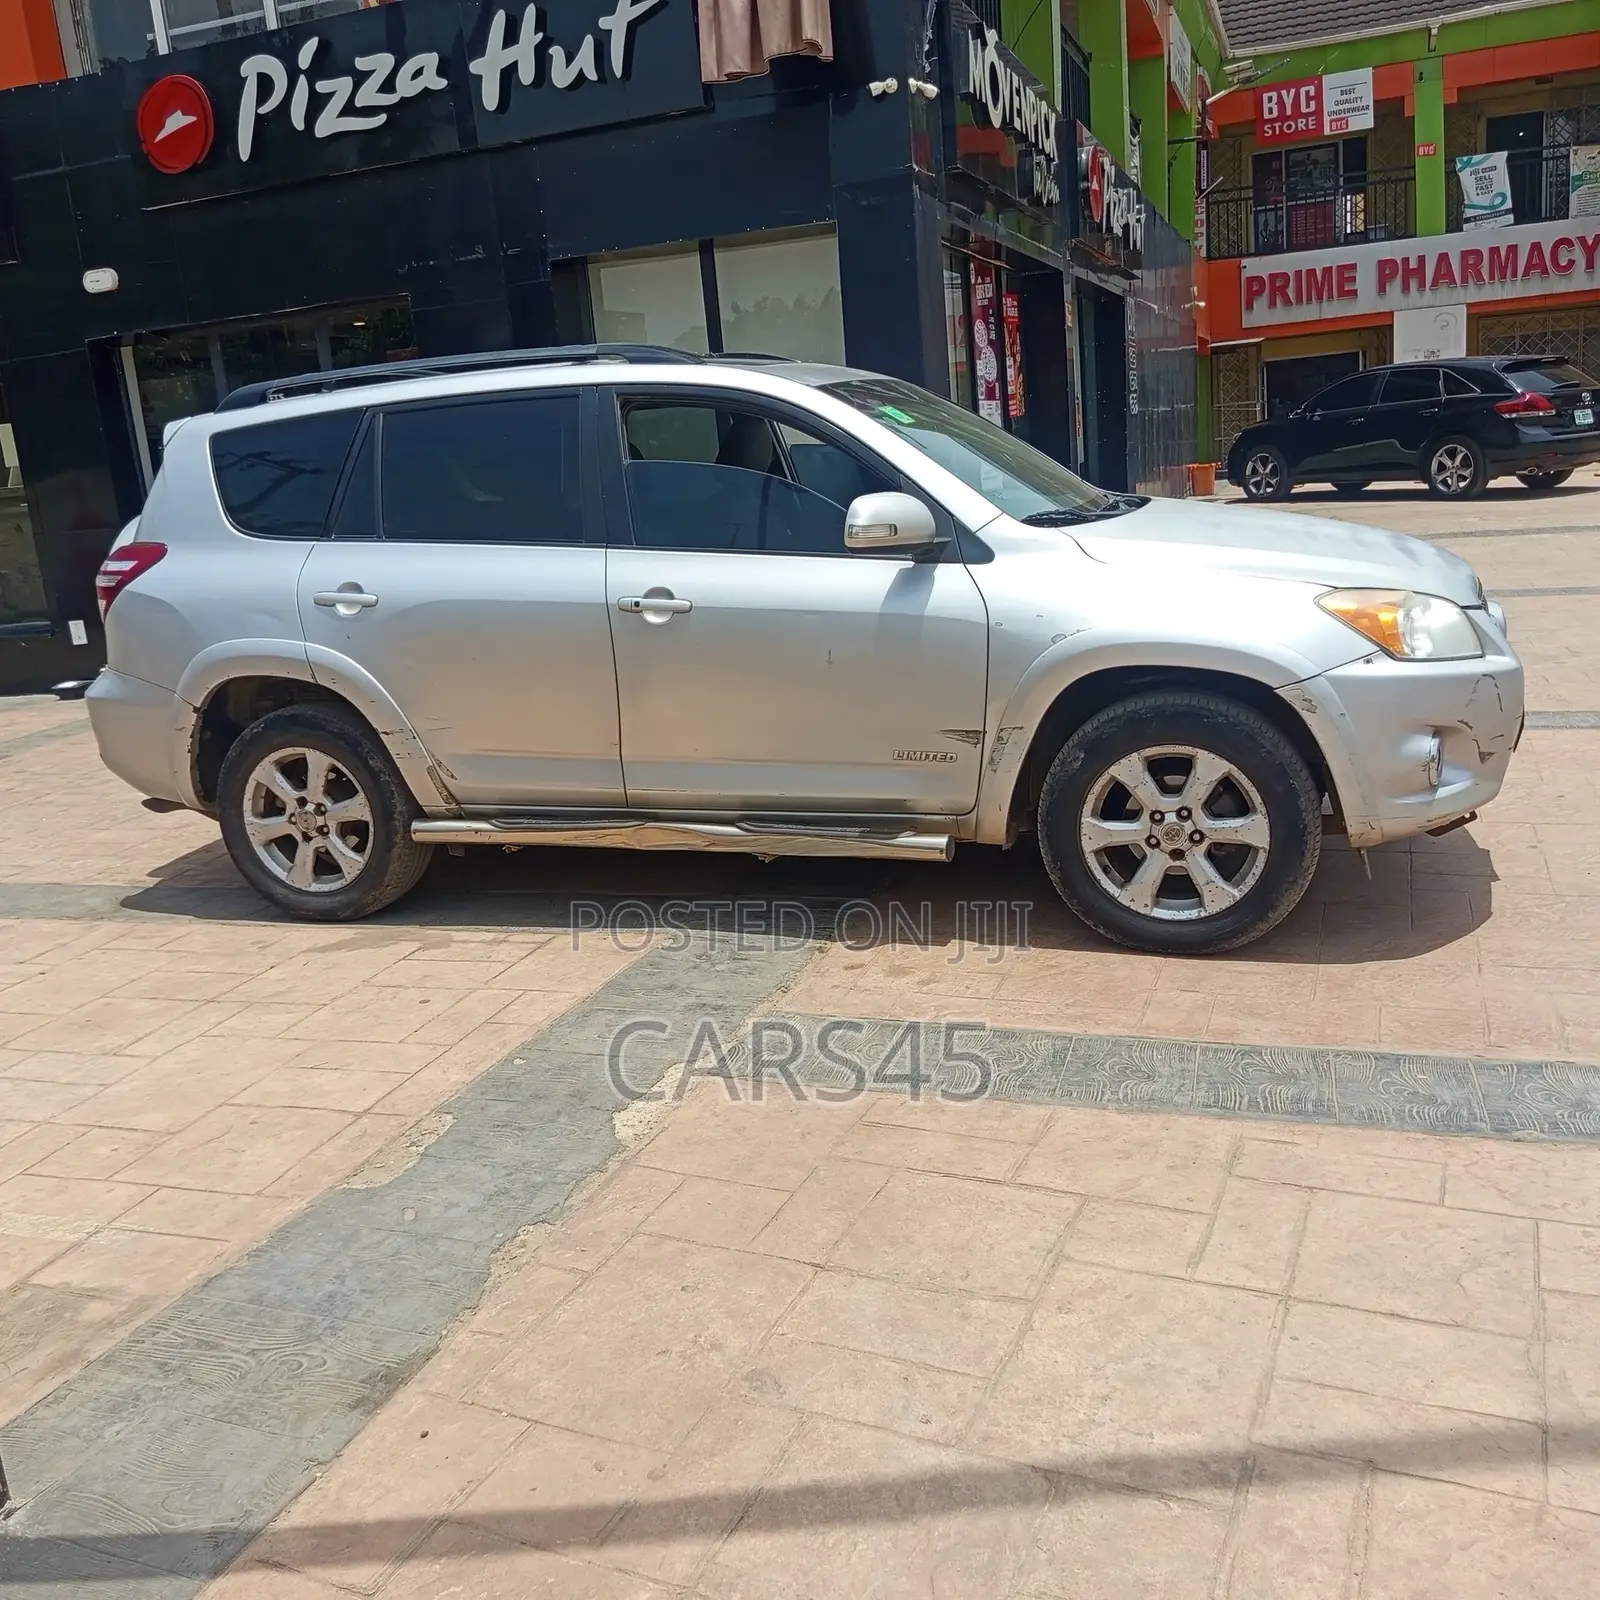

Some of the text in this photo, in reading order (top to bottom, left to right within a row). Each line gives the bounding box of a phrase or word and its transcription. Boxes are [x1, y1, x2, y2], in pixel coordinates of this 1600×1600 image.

[238, 0, 661, 163] Pizza Hut
[1340, 87, 1356, 97] BEST
[1262, 85, 1316, 120] BYC
[1333, 96, 1364, 107] QUALITY
[1327, 104, 1370, 118] UNDERWEAR
[1263, 116, 1316, 137] STORE
[1331, 119, 1347, 132] BYC
[1418, 145, 1435, 156] BYC
[1474, 174, 1493, 183] SELL
[1475, 183, 1494, 192] FAST
[1245, 233, 1600, 311] PRIME PHARMACY
[892, 750, 958, 763] LIMITED
